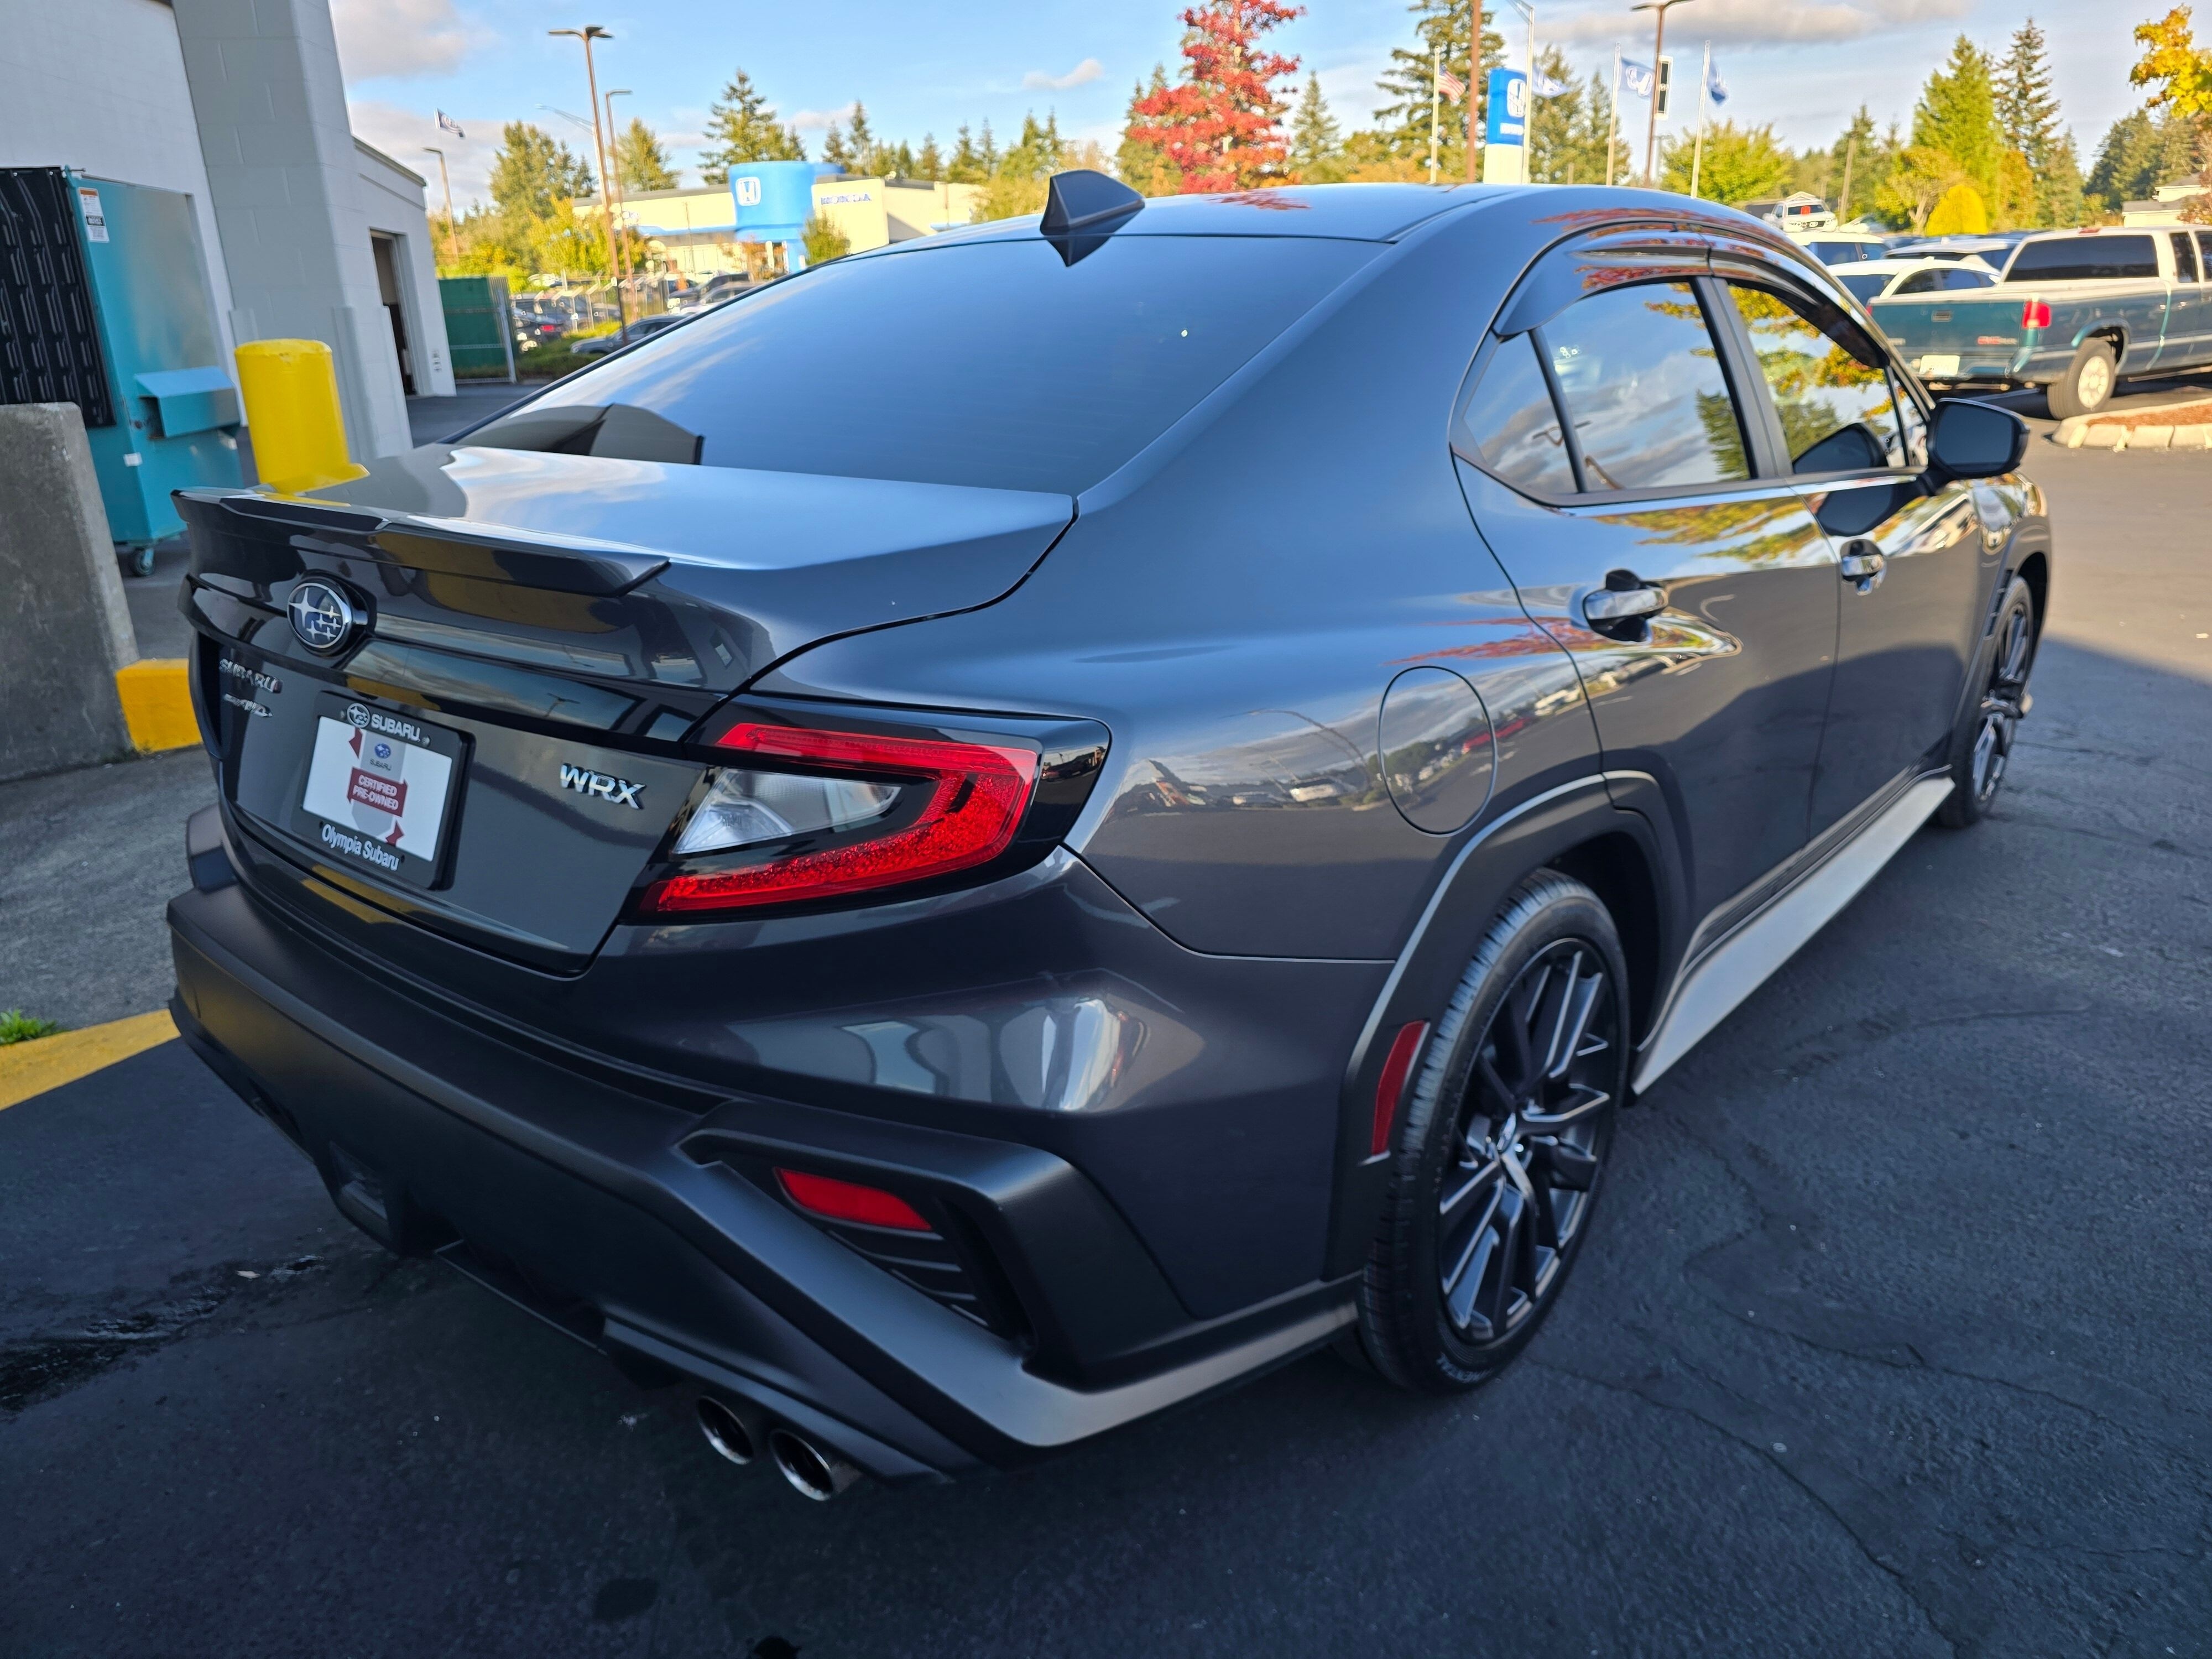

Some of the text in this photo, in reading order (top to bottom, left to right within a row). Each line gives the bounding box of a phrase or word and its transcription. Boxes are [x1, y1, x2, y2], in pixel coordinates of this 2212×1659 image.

[219, 658, 278, 692] SUBARU
[371, 713, 420, 742] SUBARU
[353, 785, 399, 811] PRE-OWNED
[358, 774, 398, 797] CERTIFIED
[560, 763, 646, 810] WRX
[322, 823, 399, 872] Olympia Subaru
